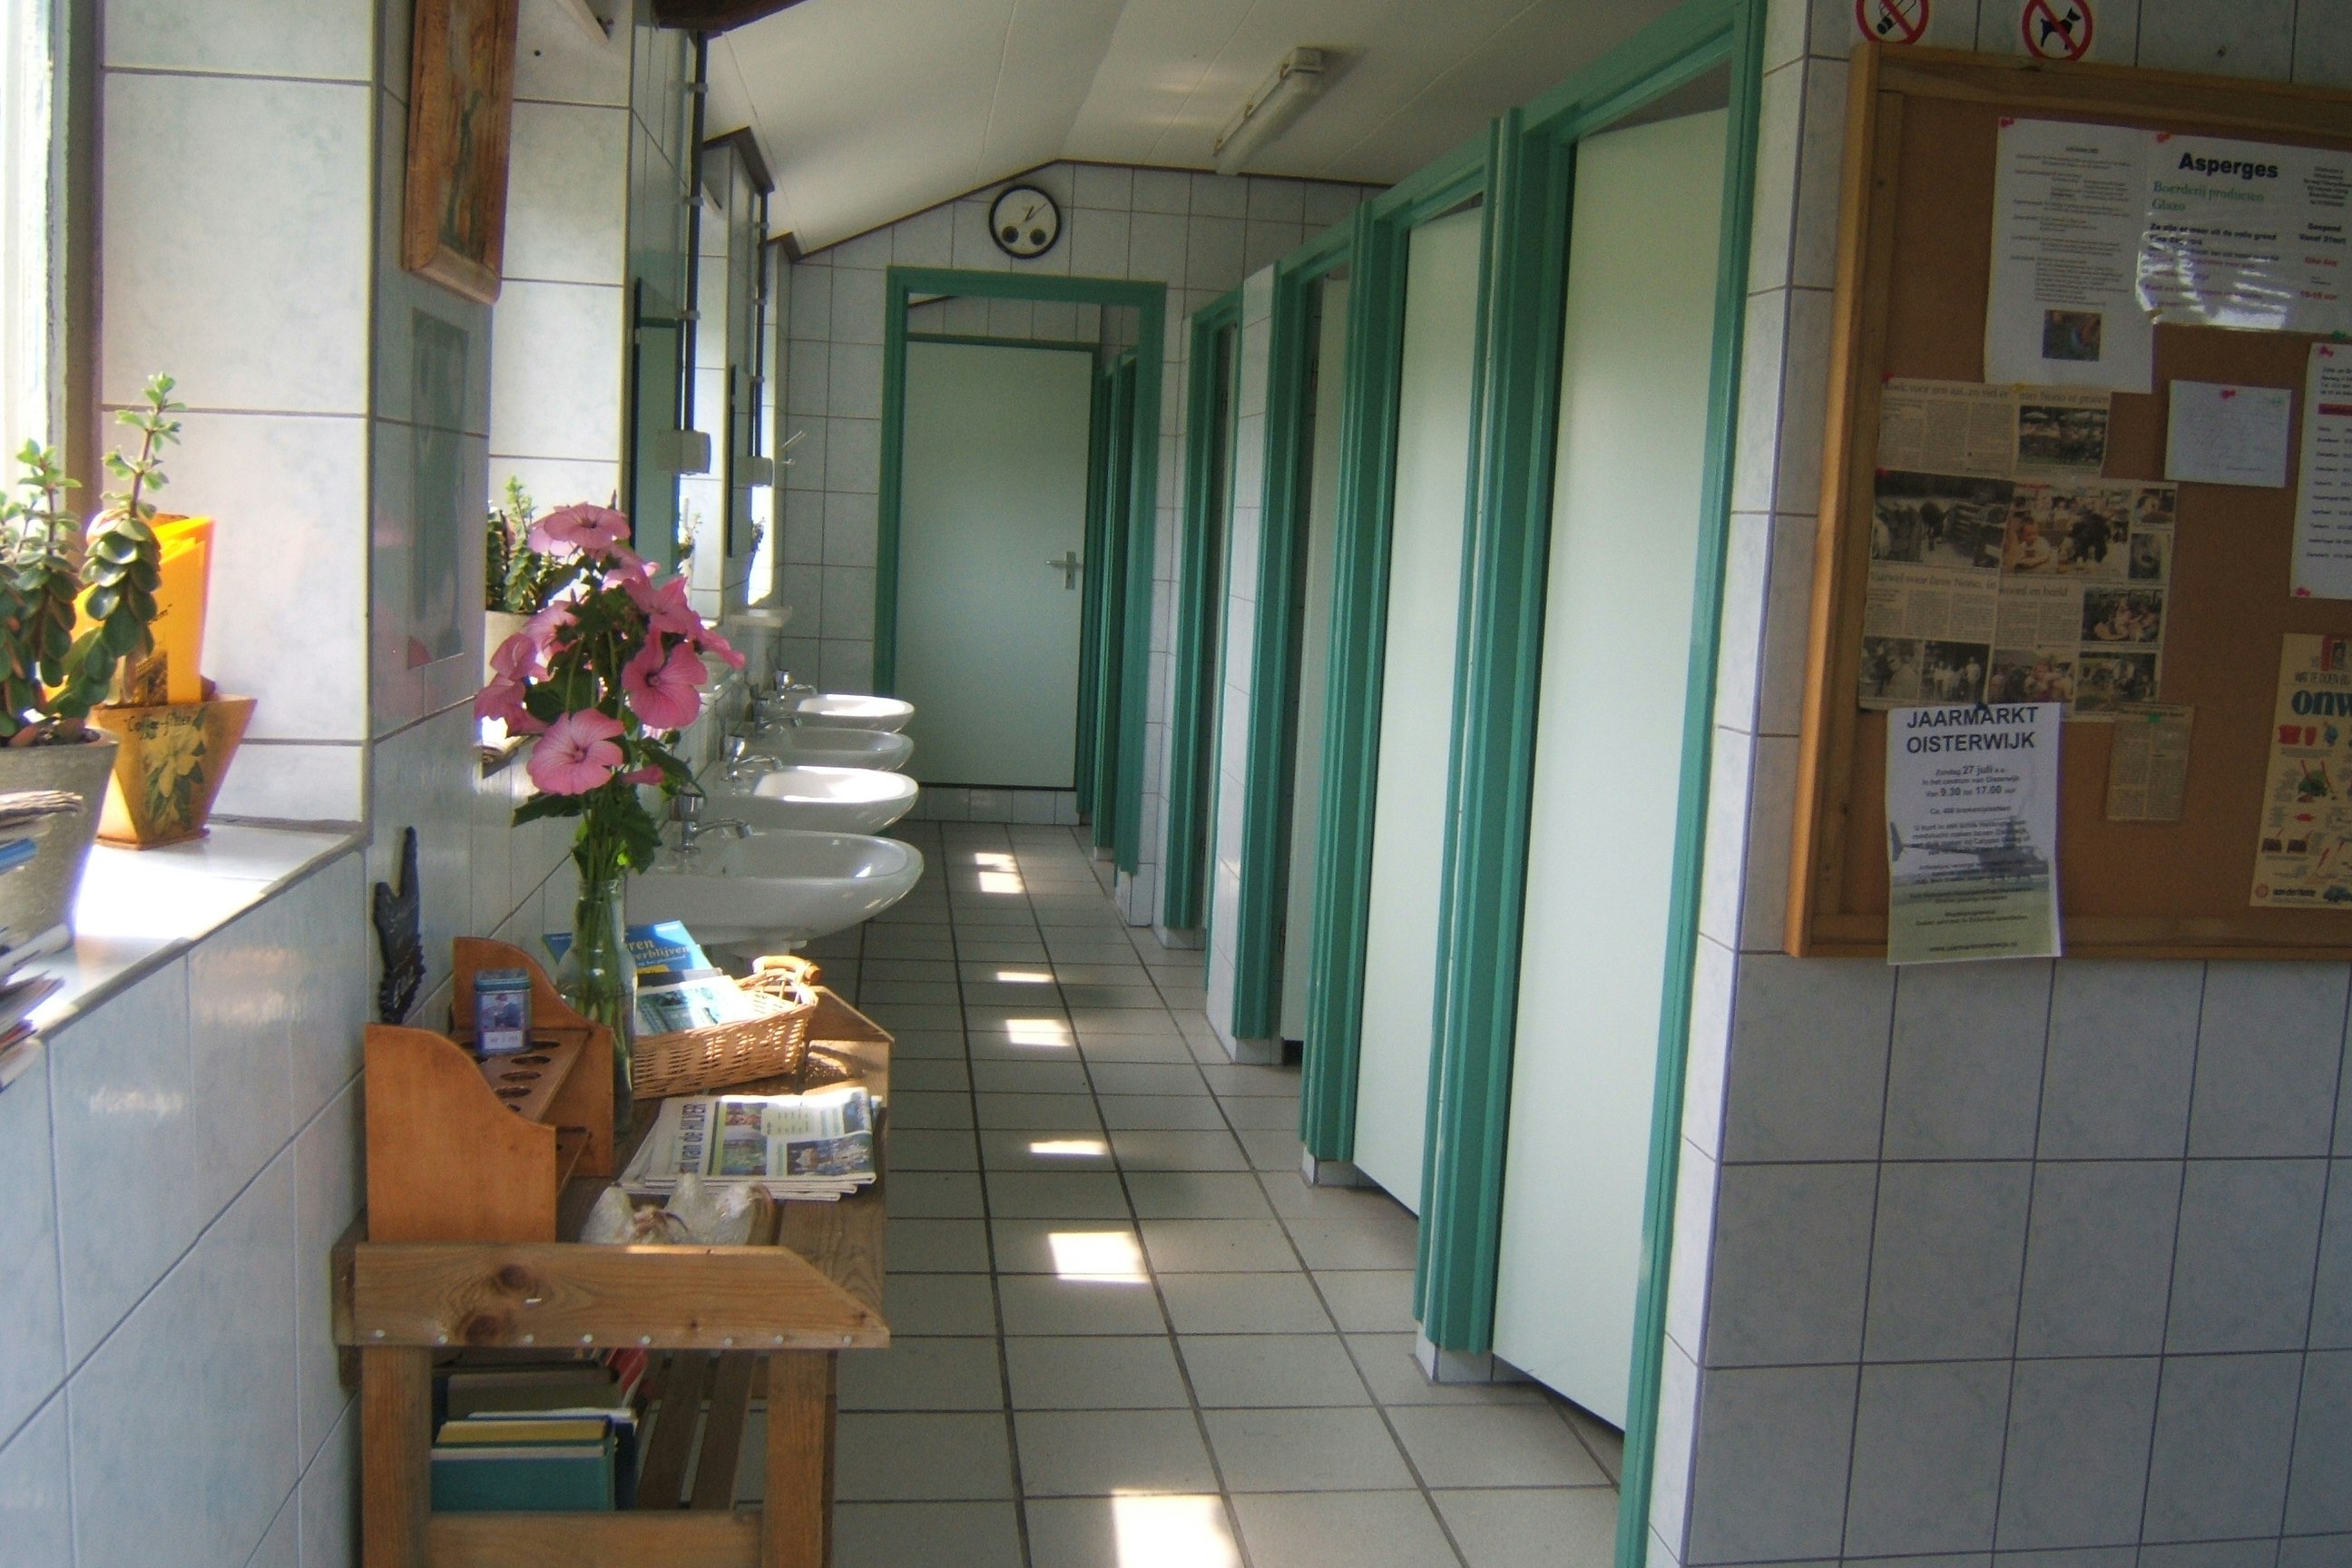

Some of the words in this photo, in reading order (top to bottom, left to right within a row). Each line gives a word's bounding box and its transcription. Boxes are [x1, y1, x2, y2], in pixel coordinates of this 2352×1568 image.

[2178, 152, 2278, 180] Asperges
[2208, 188, 2265, 203] producten
[1907, 706, 2039, 729] JAARMARKT
[1906, 731, 2035, 753] OISTERWIJK
[1963, 765, 1975, 775] 27
[1976, 764, 1993, 777] juli
[1975, 785, 2003, 795] 17.00
